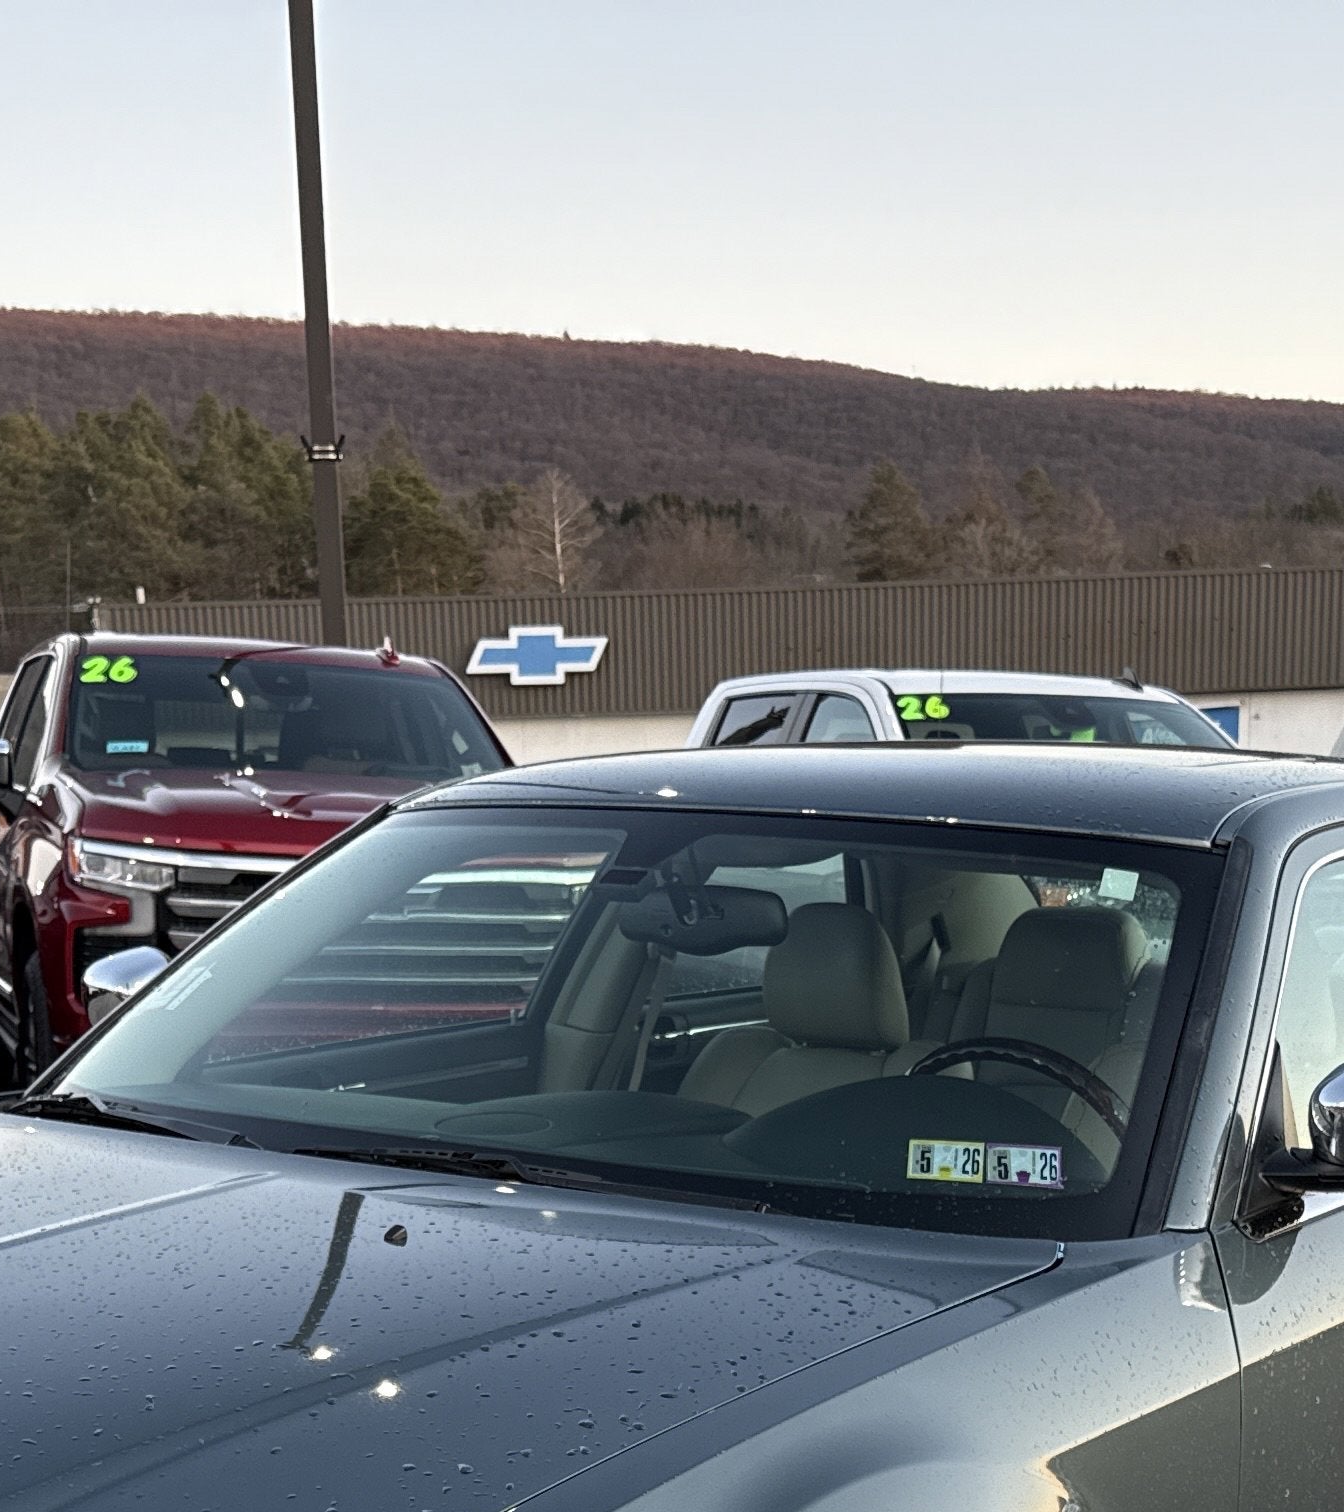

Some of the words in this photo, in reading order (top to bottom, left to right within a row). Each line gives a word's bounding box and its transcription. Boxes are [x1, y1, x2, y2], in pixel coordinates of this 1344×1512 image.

[80, 655, 138, 684] 26
[896, 695, 950, 721] 26
[919, 1150, 931, 1174] 5
[961, 1147, 981, 1175] 26
[996, 1155, 1009, 1180] 5
[1039, 1152, 1057, 1181] 26
